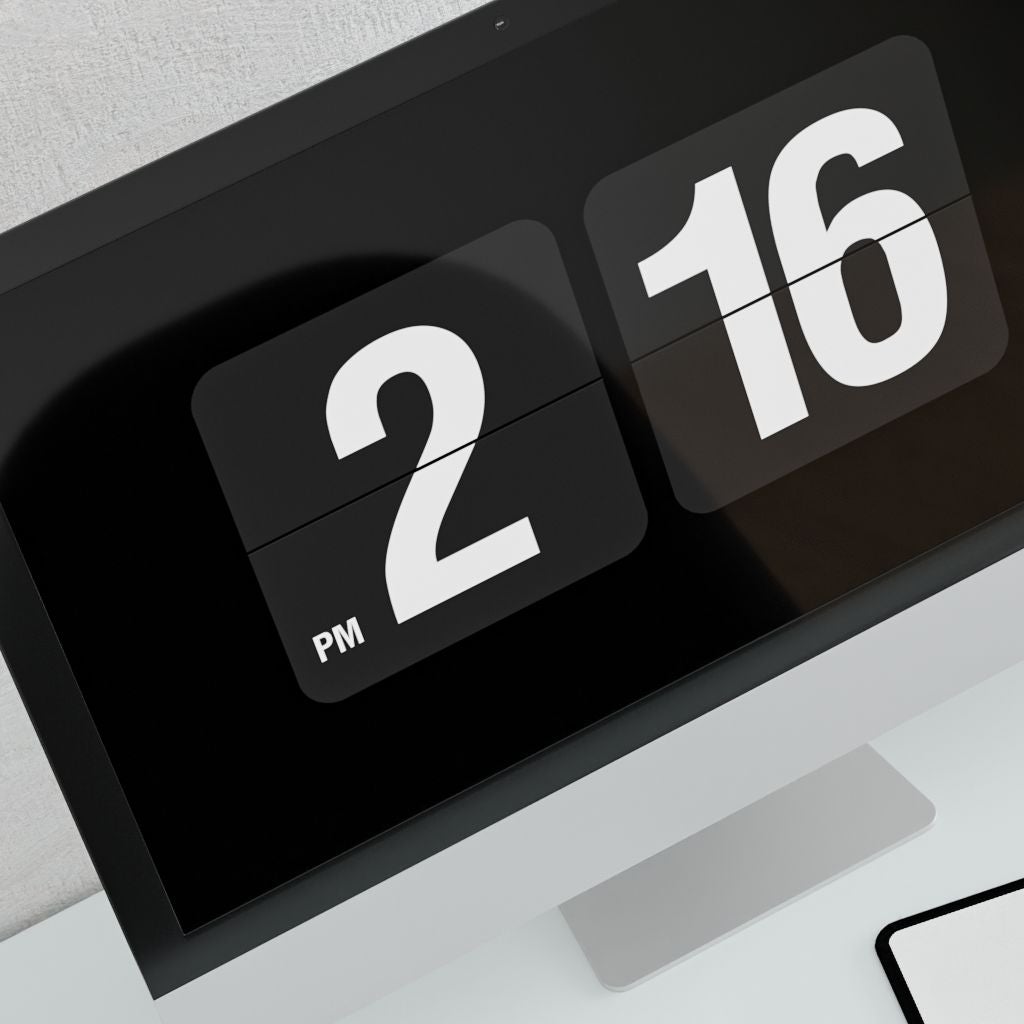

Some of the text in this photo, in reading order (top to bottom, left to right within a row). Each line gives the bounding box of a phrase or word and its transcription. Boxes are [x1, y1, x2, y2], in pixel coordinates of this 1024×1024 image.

[326, 107, 948, 624] 2 16
[312, 616, 365, 663] PM
